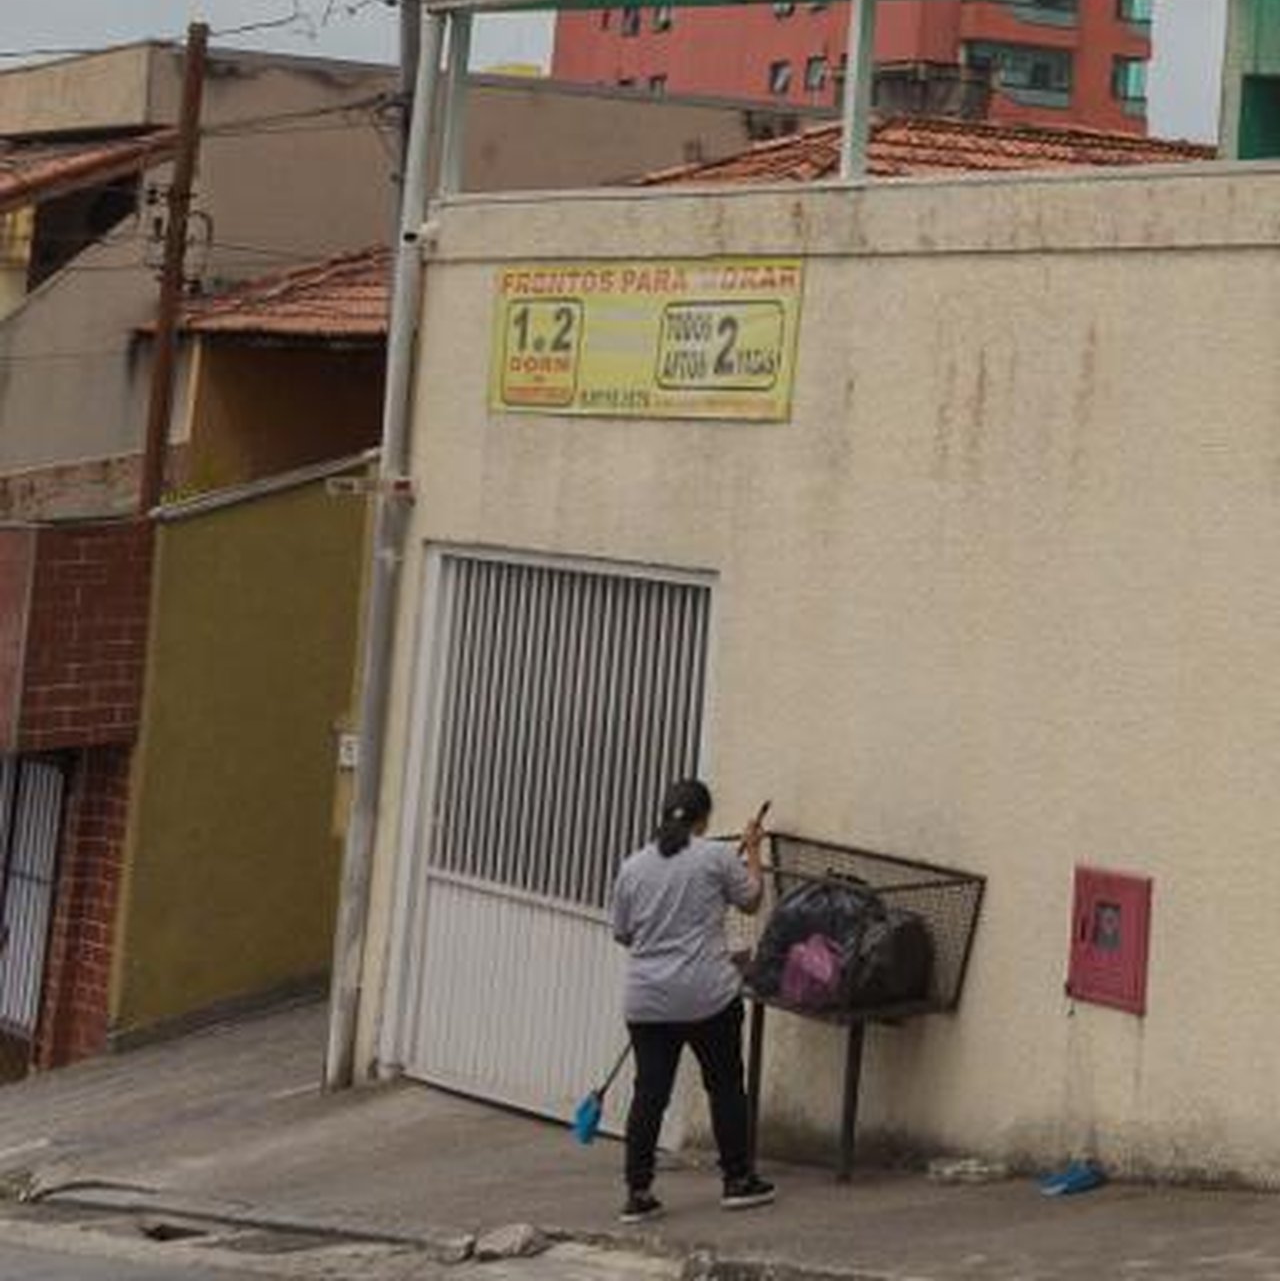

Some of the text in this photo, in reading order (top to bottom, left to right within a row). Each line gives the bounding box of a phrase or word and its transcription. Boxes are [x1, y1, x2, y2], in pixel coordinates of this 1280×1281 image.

[620, 266, 688, 294] PARA
[513, 306, 573, 352] 1.2
[712, 315, 739, 375] 2
